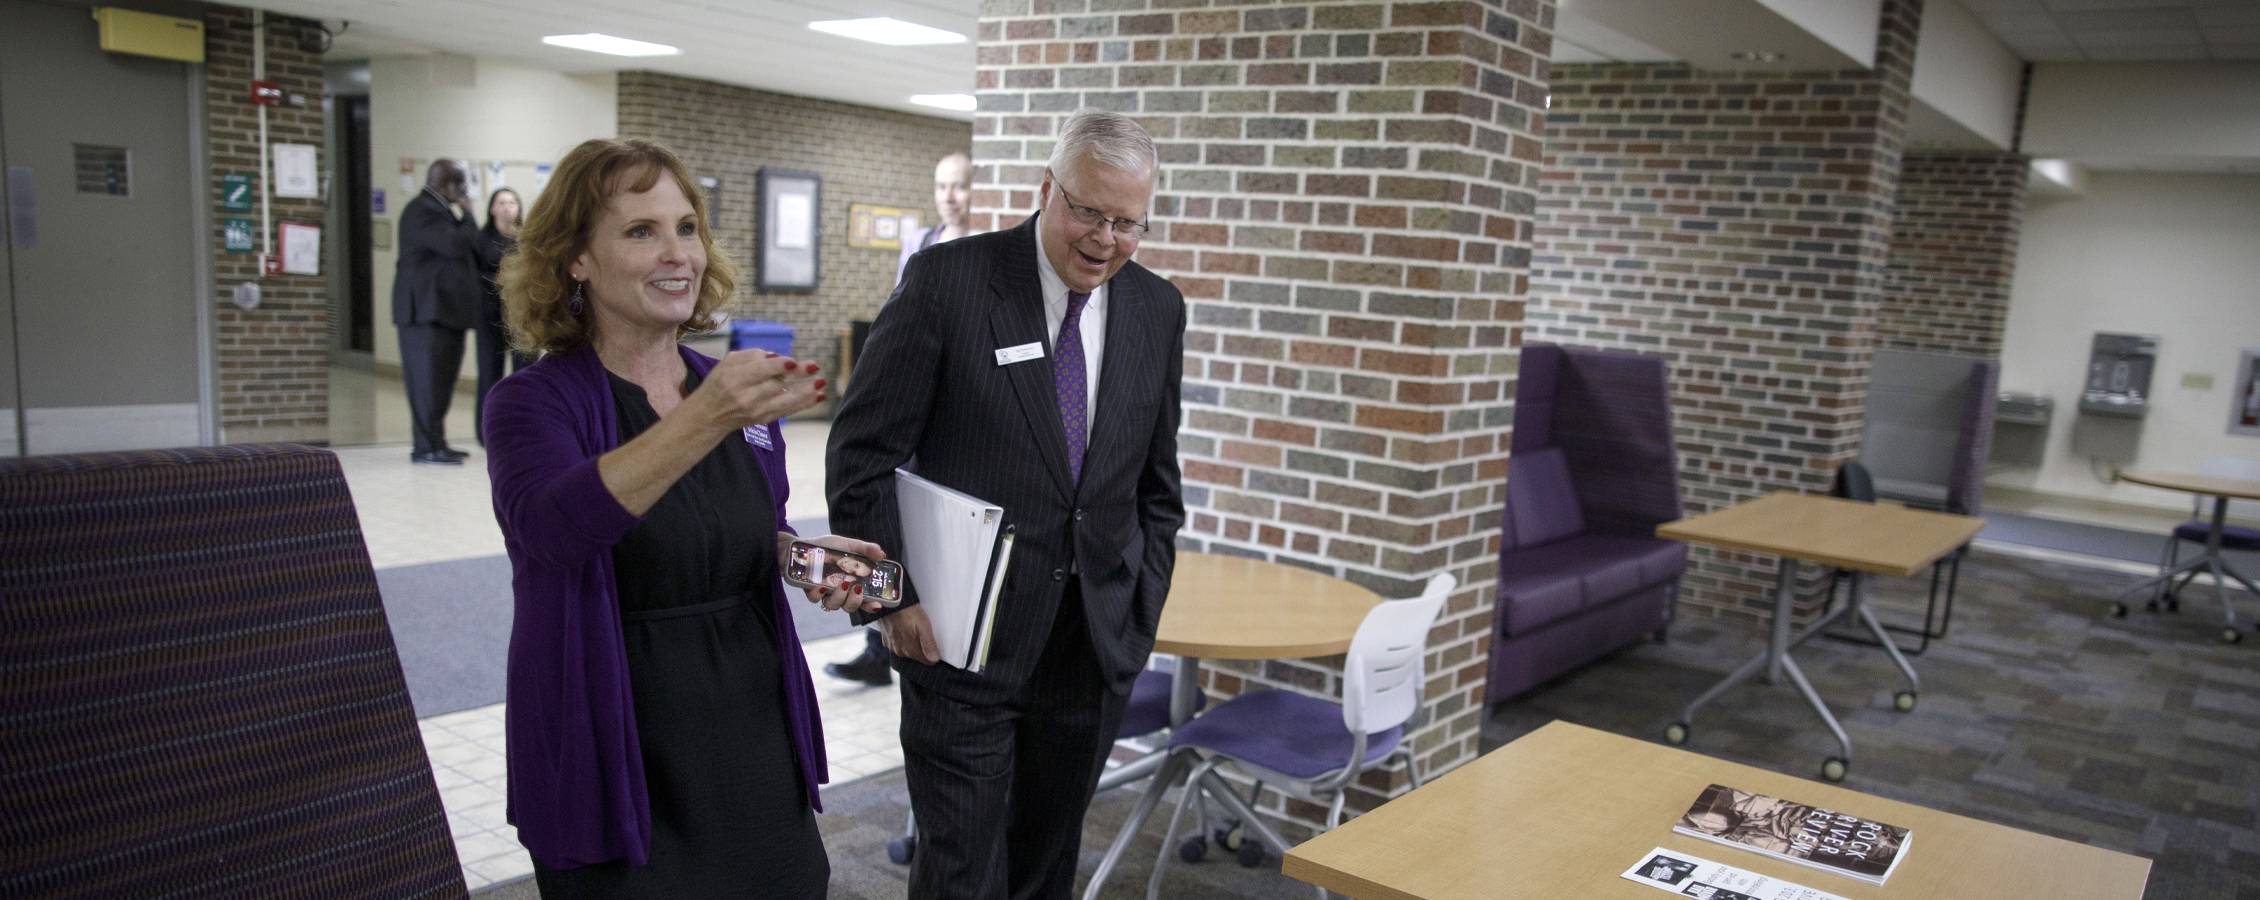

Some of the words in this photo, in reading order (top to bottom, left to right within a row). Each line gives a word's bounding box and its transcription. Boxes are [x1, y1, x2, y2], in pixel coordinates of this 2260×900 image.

[872, 569, 883, 588] 2:15
[1819, 814, 1857, 854] RIVER
[1845, 822, 1882, 859] ROCK
